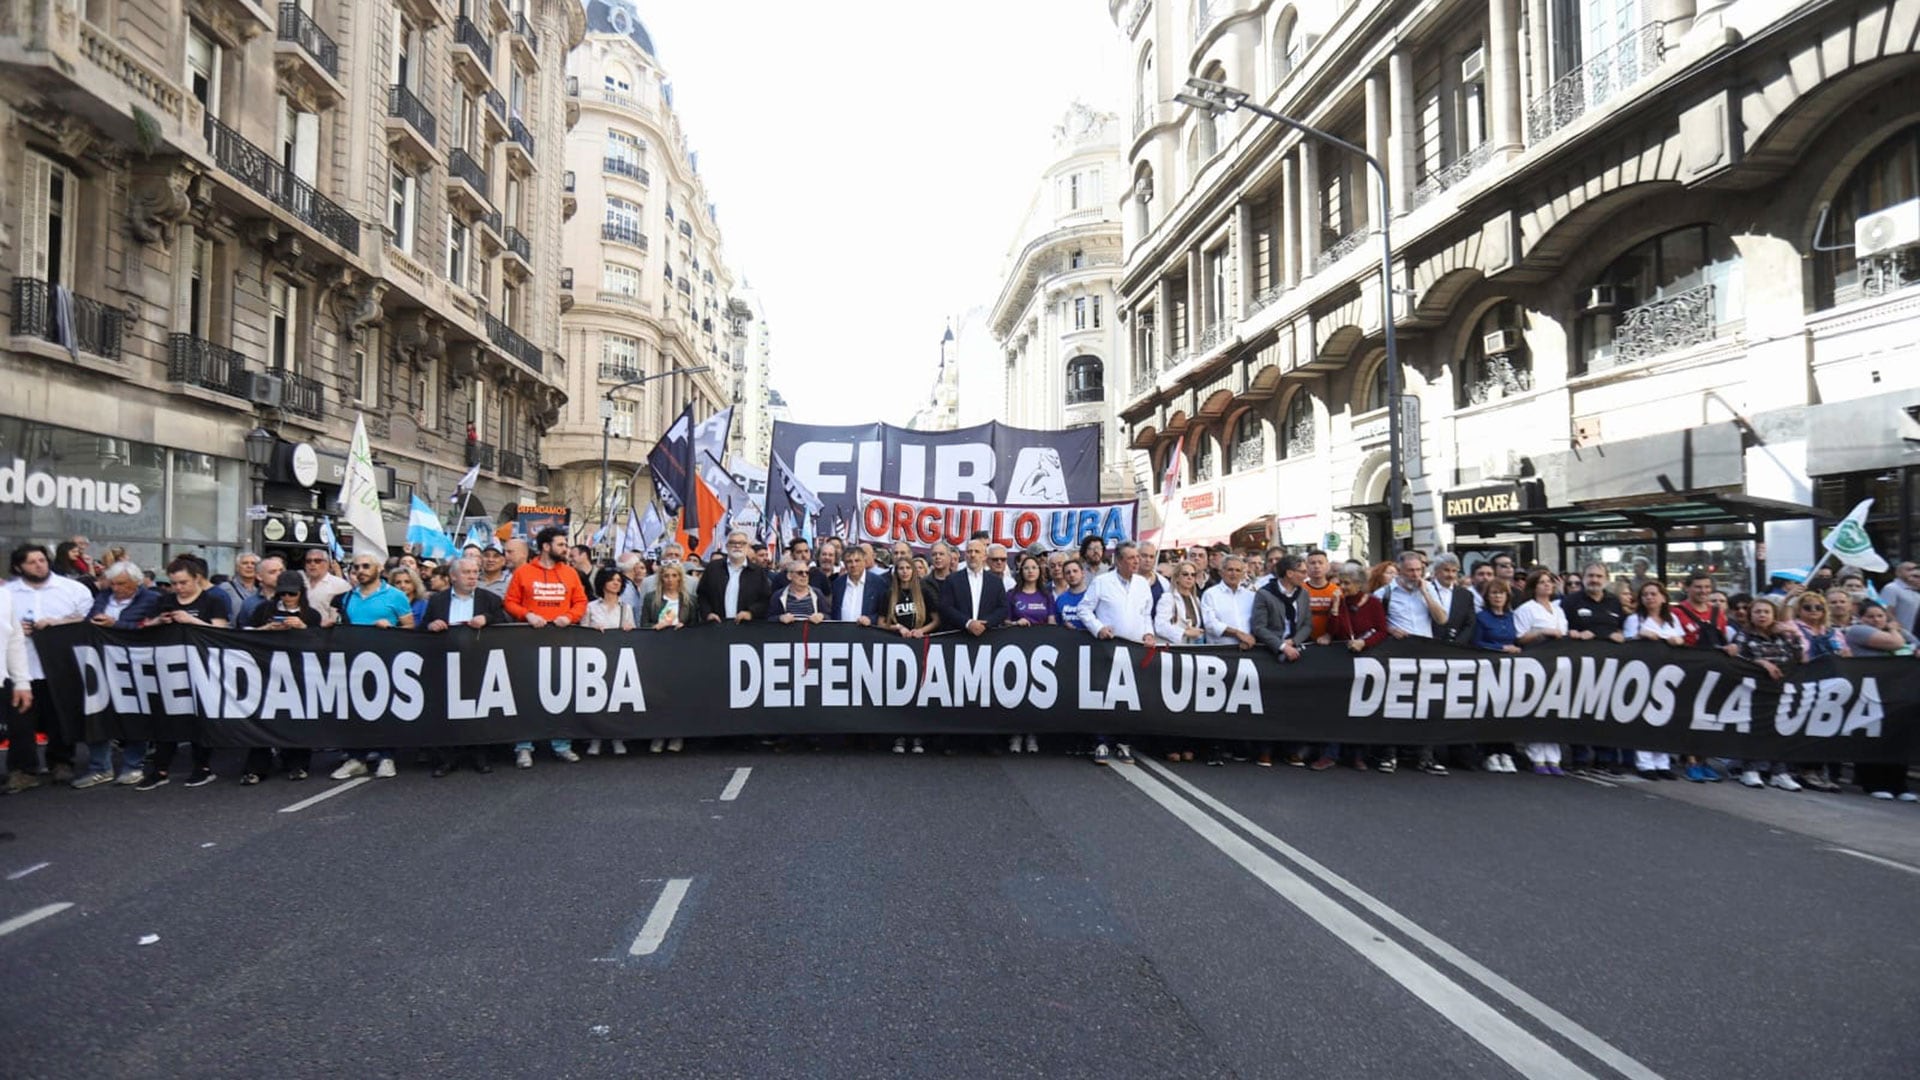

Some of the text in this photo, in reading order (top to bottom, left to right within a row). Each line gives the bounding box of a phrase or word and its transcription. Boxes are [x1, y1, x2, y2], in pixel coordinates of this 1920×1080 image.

[0, 458, 141, 515] domus
[794, 440, 1070, 505] FUBA
[517, 505, 567, 515] DEFENDAMOS
[864, 498, 1041, 549] ORGULLO
[1050, 506, 1126, 548] UBA
[1447, 494, 1510, 516] FATI CAFE
[895, 603, 916, 612] FUB
[73, 645, 647, 721] DEFENDAMOS LA UBA
[729, 642, 1264, 714] DEFENDAMOS LA UBA
[1348, 656, 1884, 737] DEFENDAMOS LA UBA
